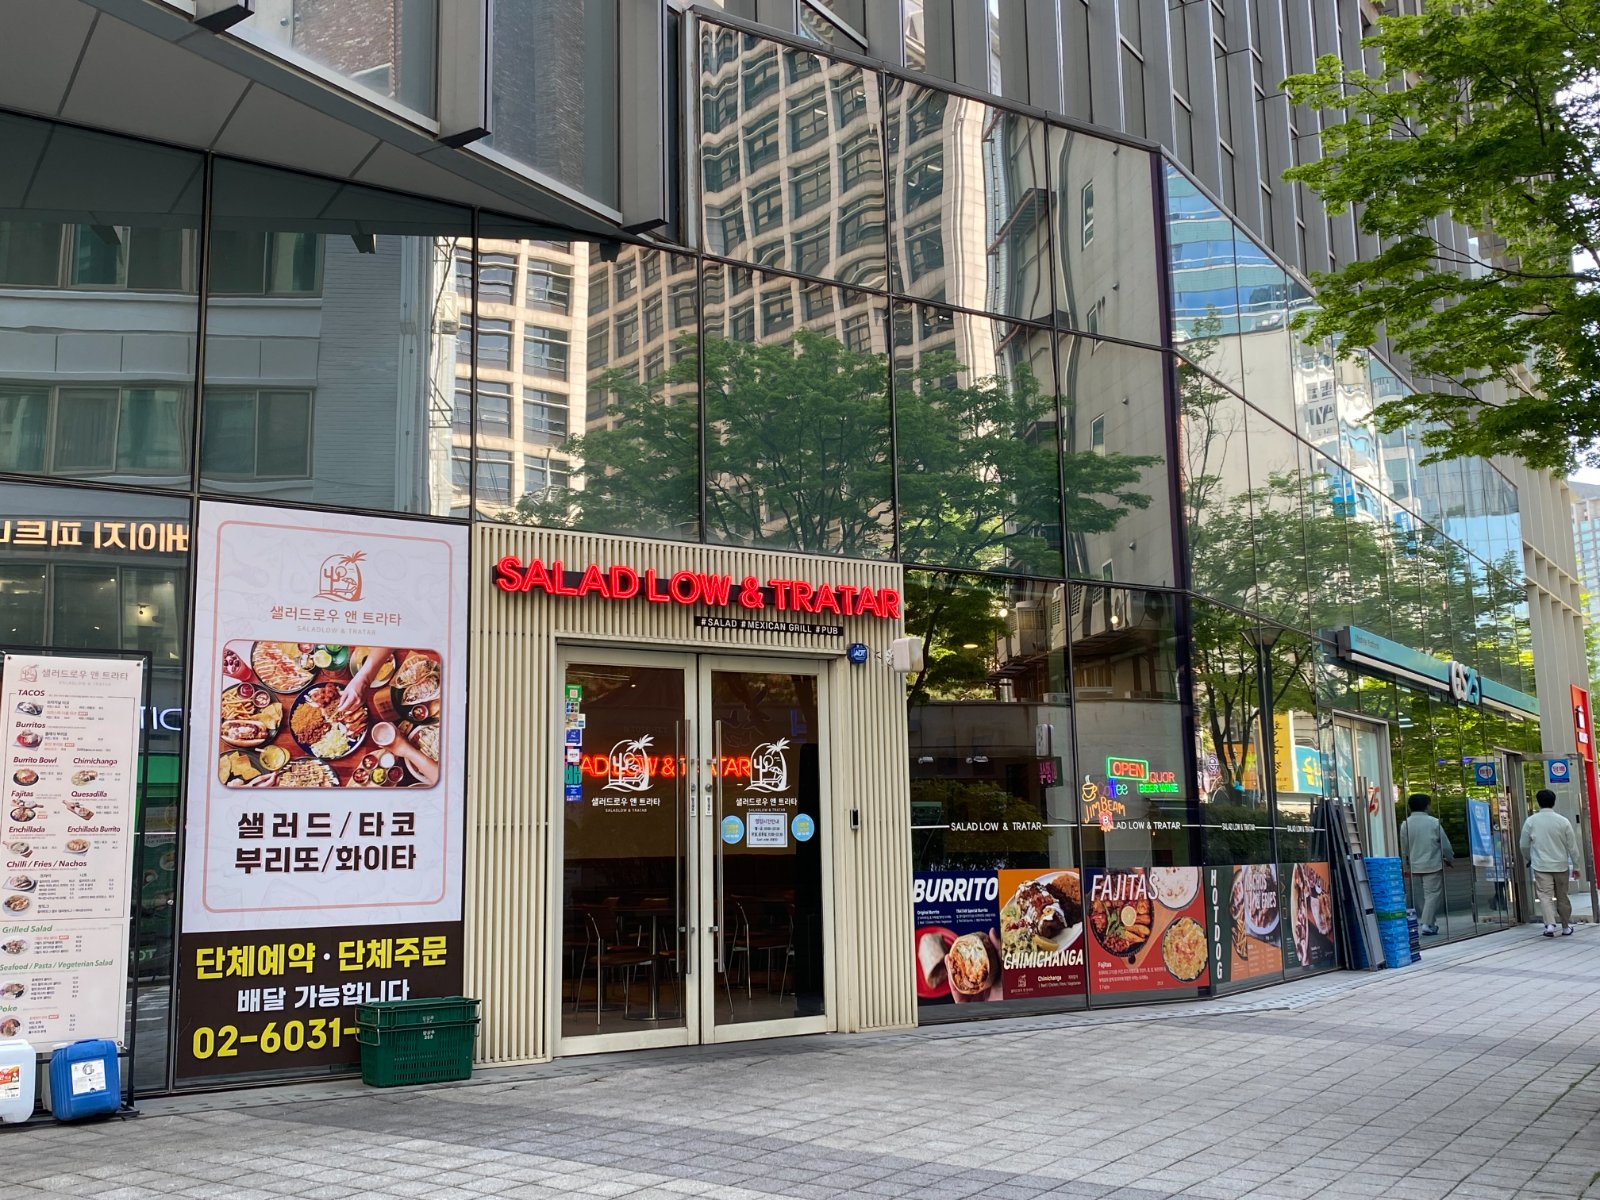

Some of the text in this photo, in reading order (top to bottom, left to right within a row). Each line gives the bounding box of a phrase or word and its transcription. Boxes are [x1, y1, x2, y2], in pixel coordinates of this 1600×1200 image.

[496, 556, 901, 619] SALAD LOW & TRATAR
[270, 605, 403, 627] 샐러드로우 앤 트라타
[701, 617, 839, 635] #SALAD #MEXICAN GRILL #PUB
[18, 689, 45, 697] TACOS
[16, 721, 46, 729] Burritos
[13, 756, 38, 764] Burrito
[73, 757, 118, 767] Chimichanga
[1112, 761, 1144, 778] OPEN
[1138, 783, 1179, 793] BEER WINE
[11, 790, 34, 799] Fajitas
[71, 790, 108, 798] Quesadilla
[591, 797, 628, 806] 샐러드로우
[736, 798, 768, 806] 샐러드로우
[951, 820, 1042, 832] SALAD LOW & TRATAR
[1128, 821, 1145, 830] LOW
[1146, 821, 1152, 830] &
[1153, 821, 1181, 830] TRATAR
[33, 860, 52, 868] Fries
[58, 859, 88, 868] Nachos
[913, 876, 999, 903] BURRITO
[1091, 874, 1160, 902] FAJITAS
[2, 925, 30, 934] Grilled
[30, 924, 53, 932] Salad
[196, 942, 316, 980] 단체예약
[338, 935, 448, 972] 단체주문
[1003, 949, 1084, 971] CHIMICHANGA
[34, 962, 52, 970] Pasta
[94, 959, 113, 967] Salad
[237, 978, 410, 1013] 배달 가능합니다
